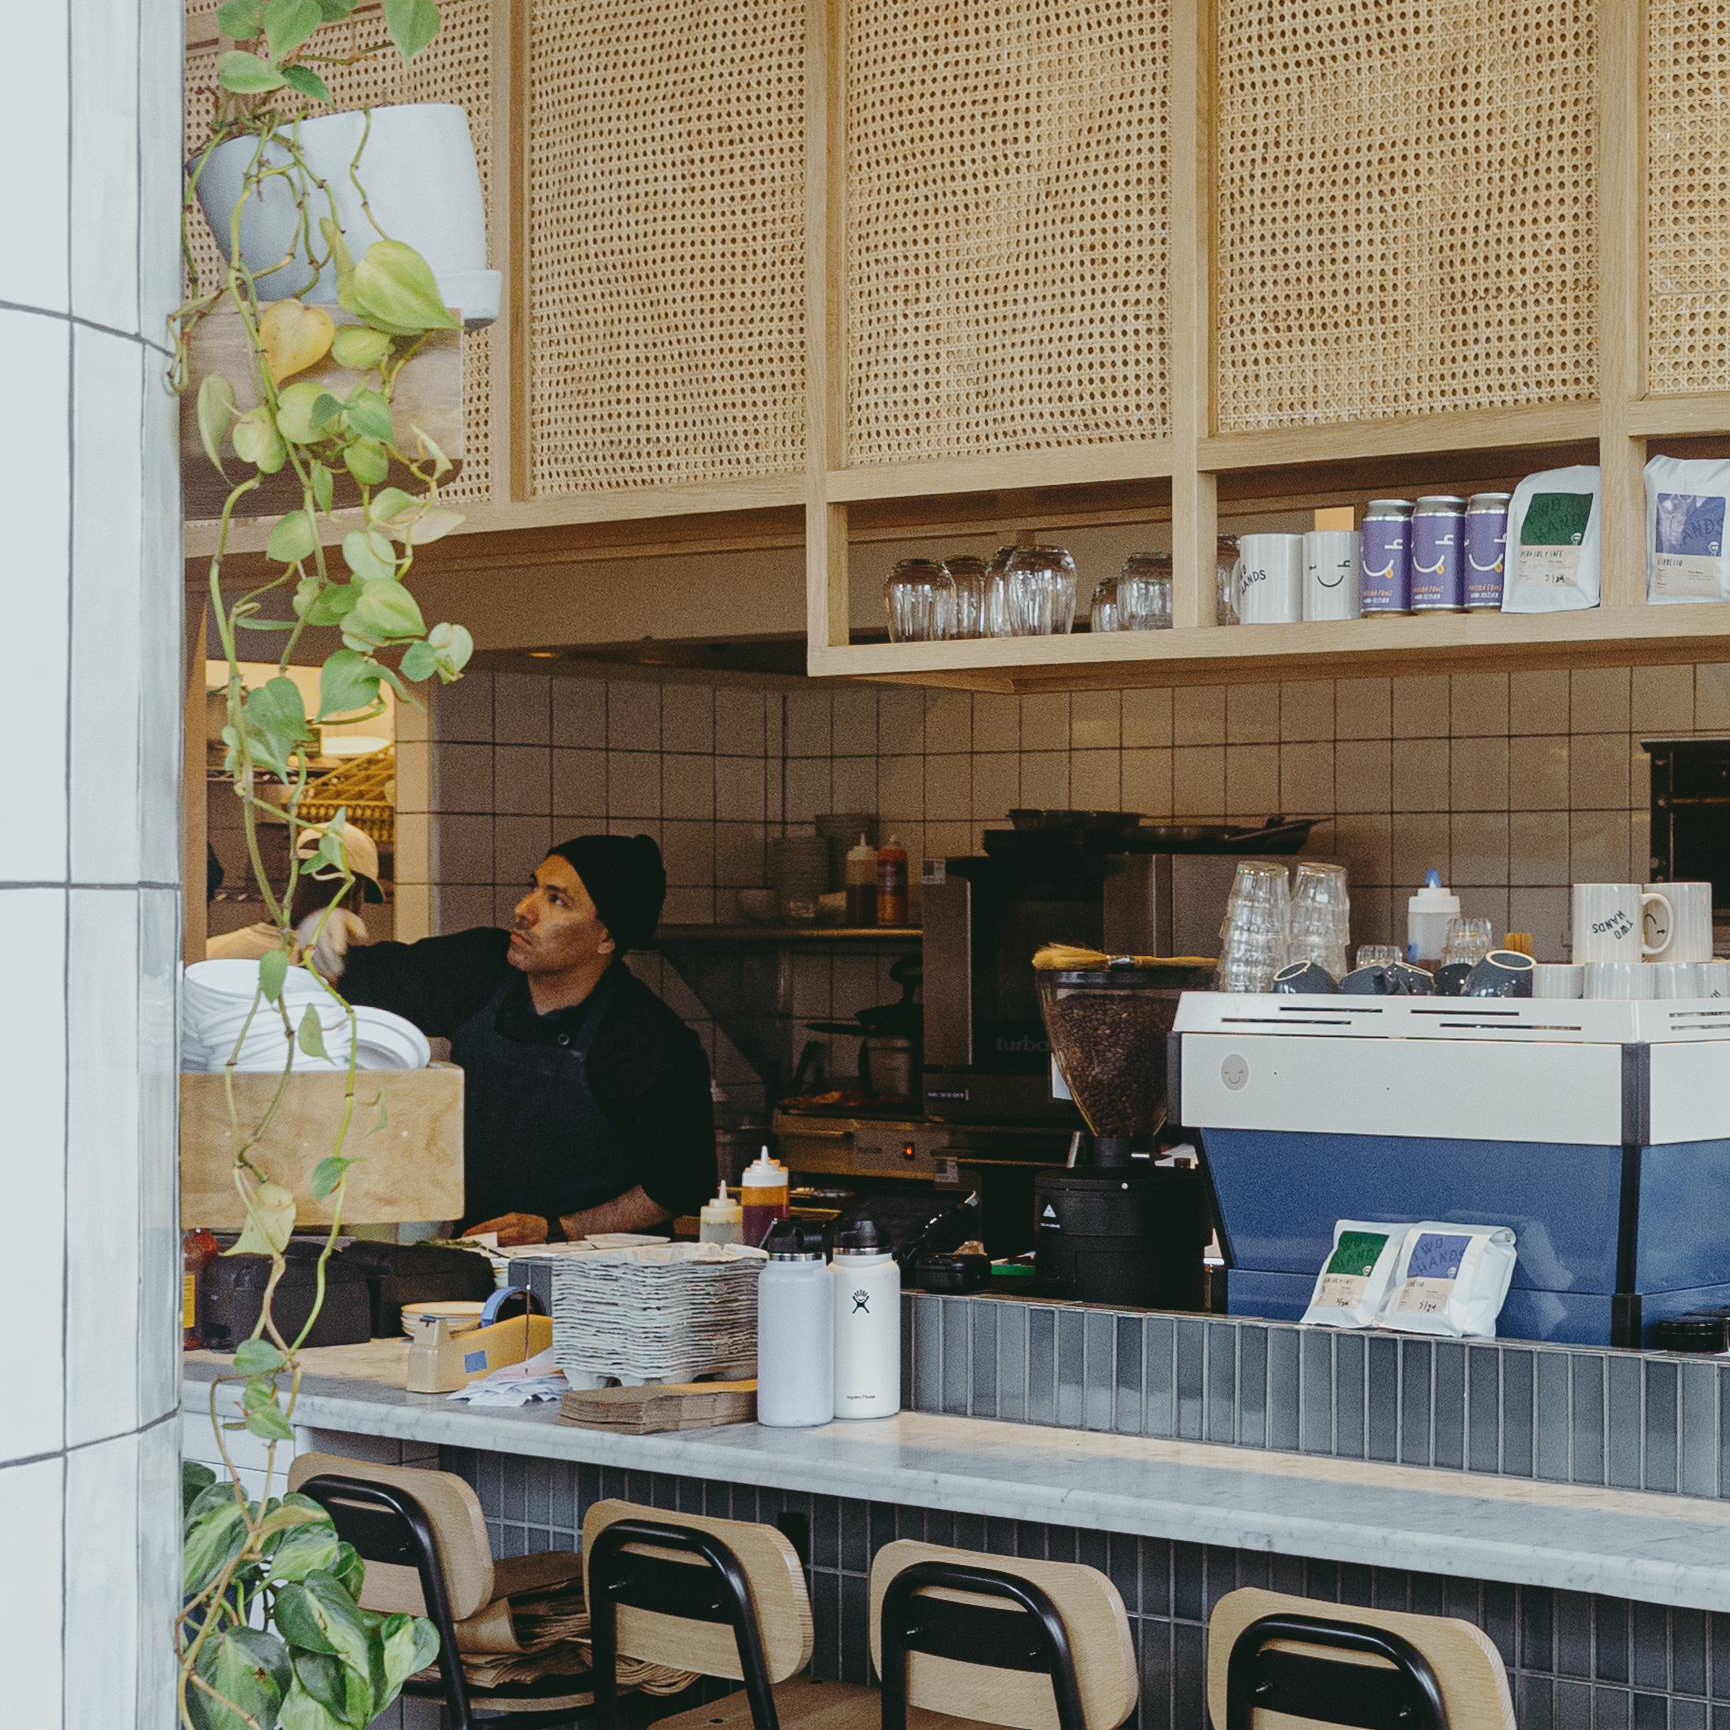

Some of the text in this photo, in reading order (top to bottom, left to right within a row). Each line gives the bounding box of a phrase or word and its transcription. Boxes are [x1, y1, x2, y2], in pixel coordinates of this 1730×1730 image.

[1657, 558, 1683, 567] ESPRESSO
[1591, 910, 1626, 934] HANDS
[1614, 919, 1634, 940] TWO
